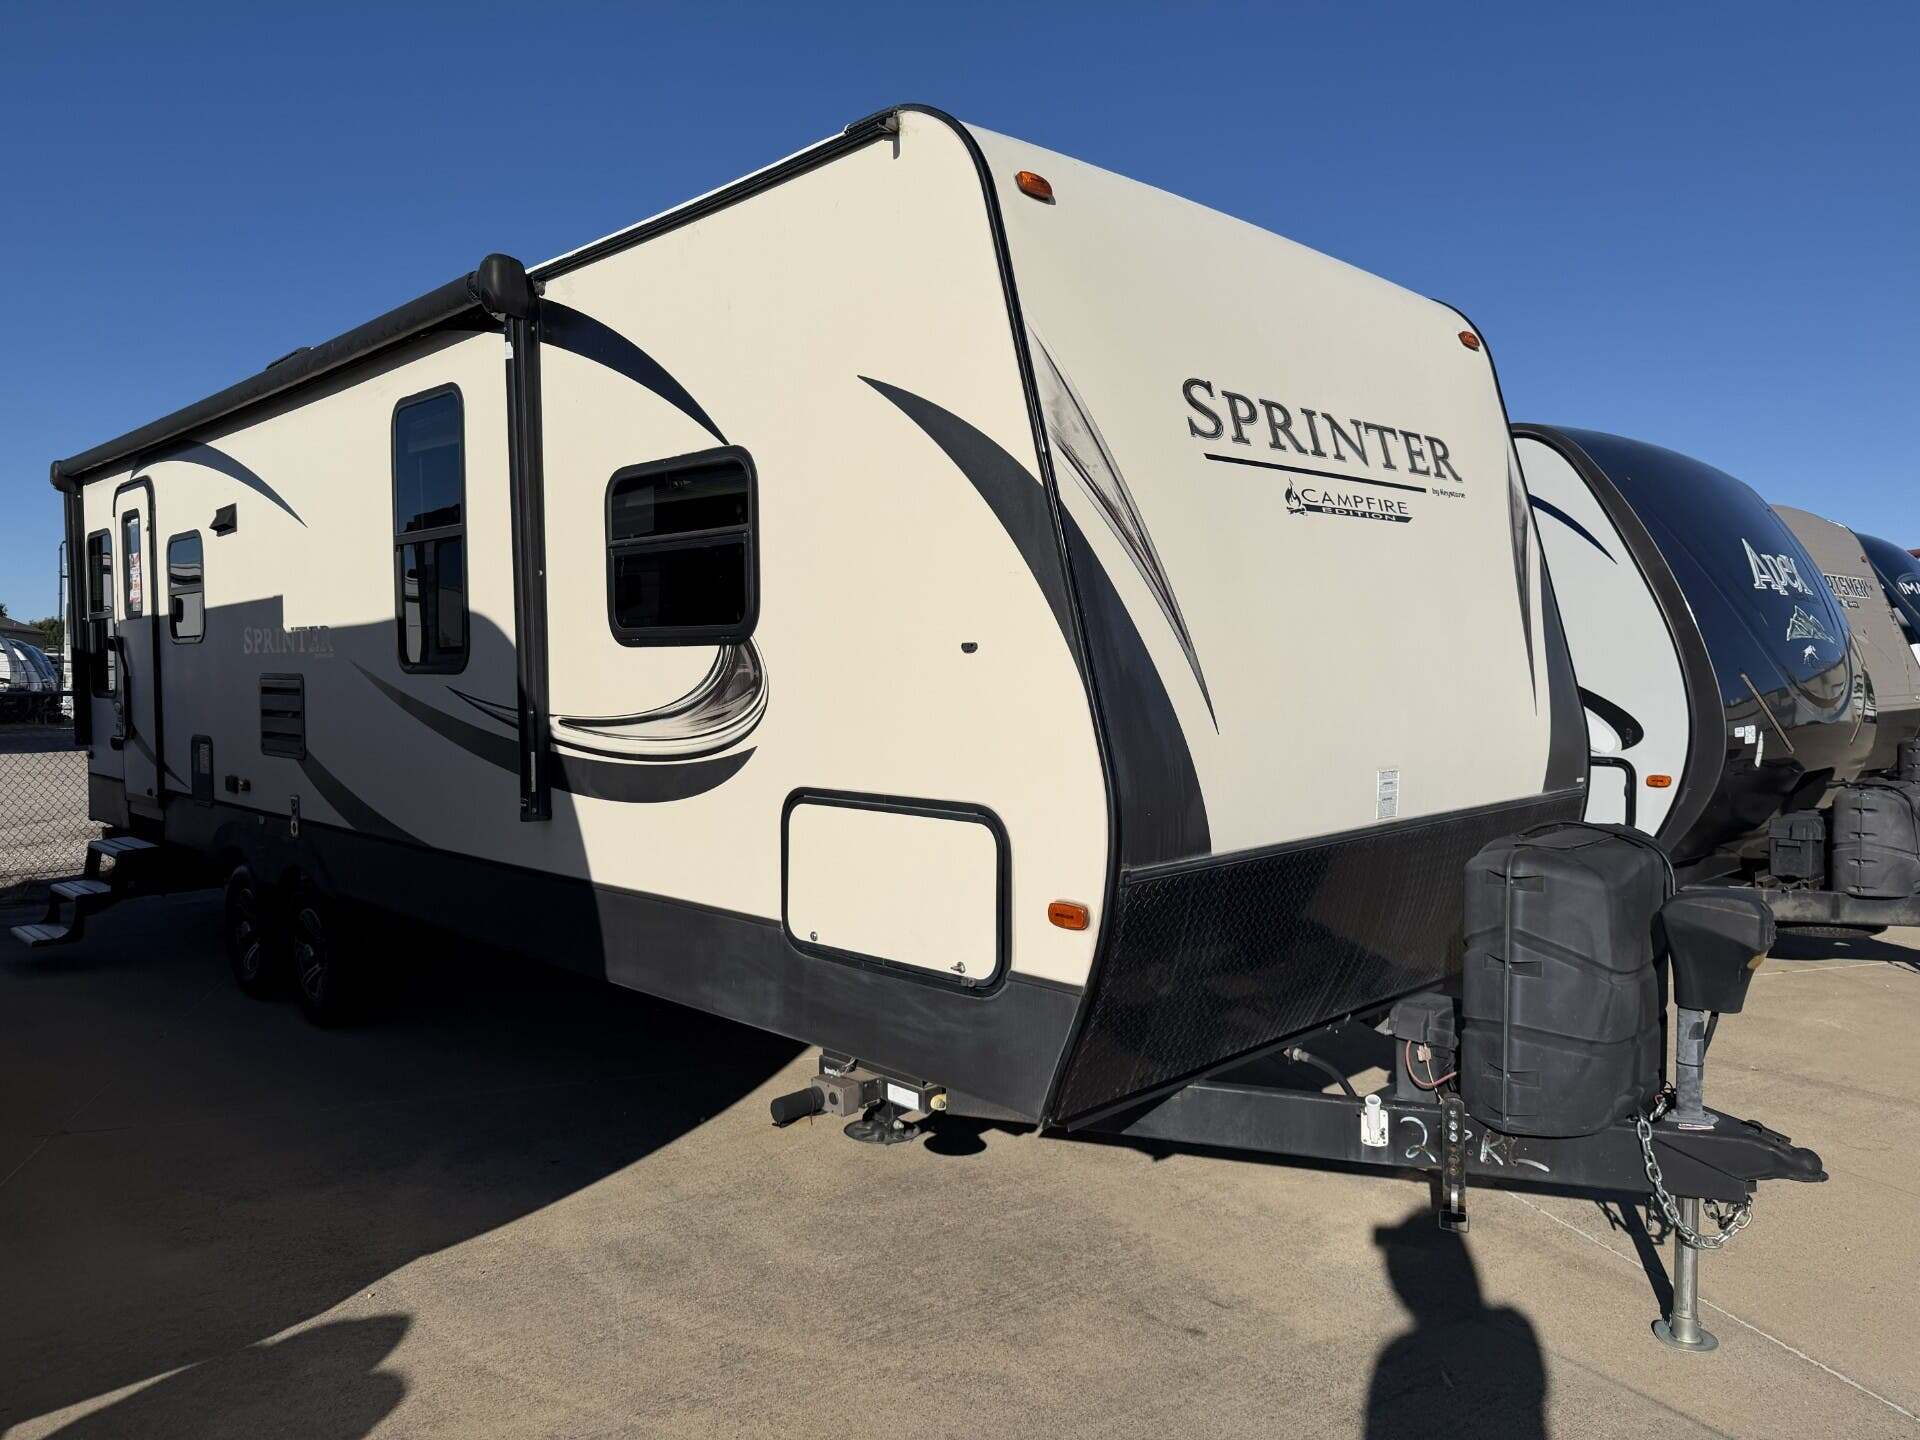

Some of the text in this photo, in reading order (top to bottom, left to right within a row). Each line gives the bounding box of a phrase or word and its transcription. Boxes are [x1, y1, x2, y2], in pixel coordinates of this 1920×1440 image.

[1182, 377, 1463, 483] SPRINTER
[1301, 488, 1409, 515] CAMPFIRE
[1321, 506, 1397, 522] EDITION
